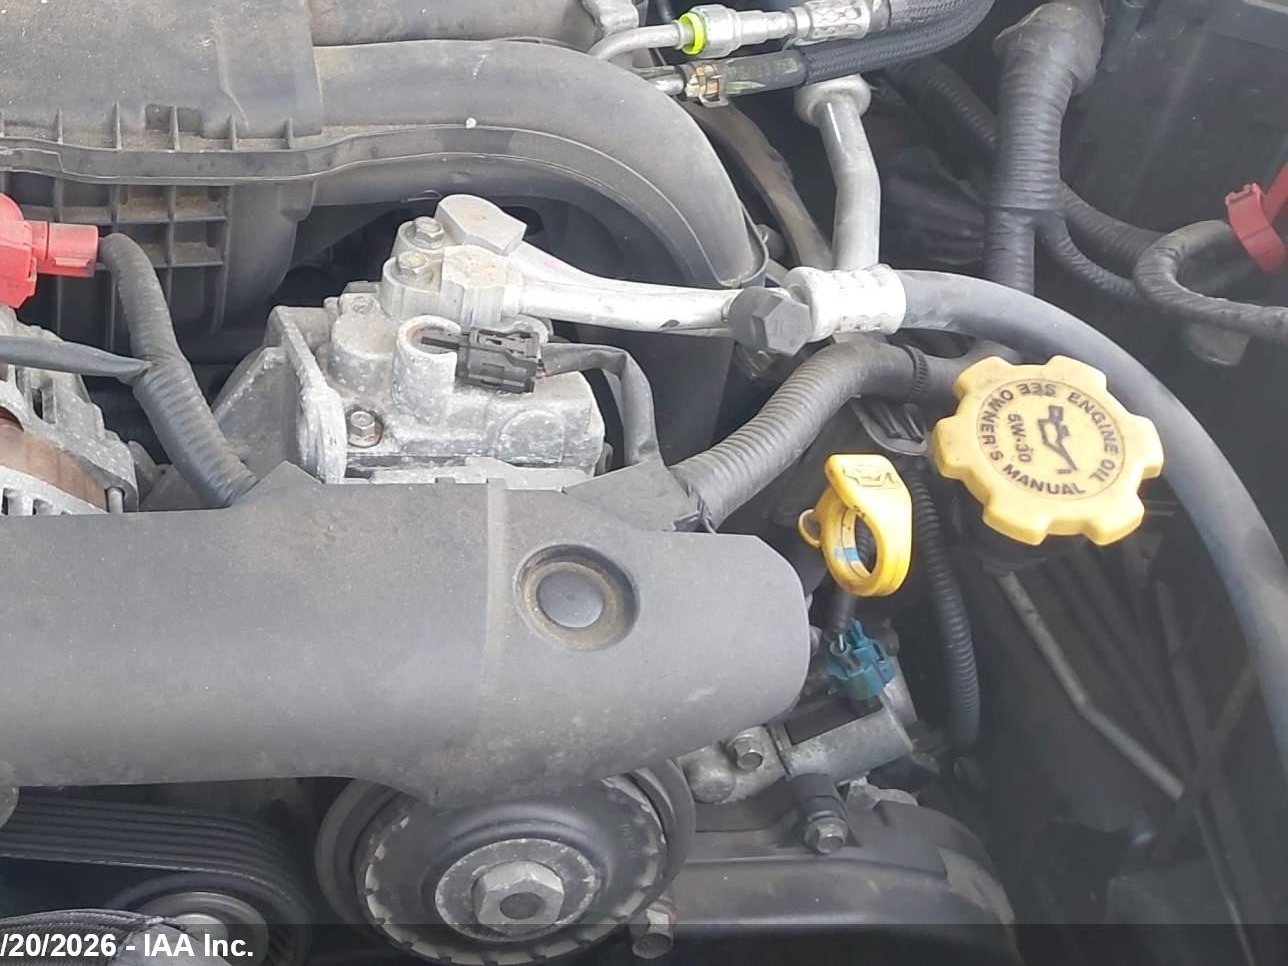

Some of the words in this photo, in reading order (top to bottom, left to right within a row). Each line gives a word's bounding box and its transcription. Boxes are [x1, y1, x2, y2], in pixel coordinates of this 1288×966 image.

[1015, 382, 1057, 398] SEE
[980, 389, 1015, 462] OWNER'S
[1066, 391, 1119, 456] ENGINE
[1002, 463, 1087, 496] MANUAL
[1088, 458, 1117, 483] OIL
